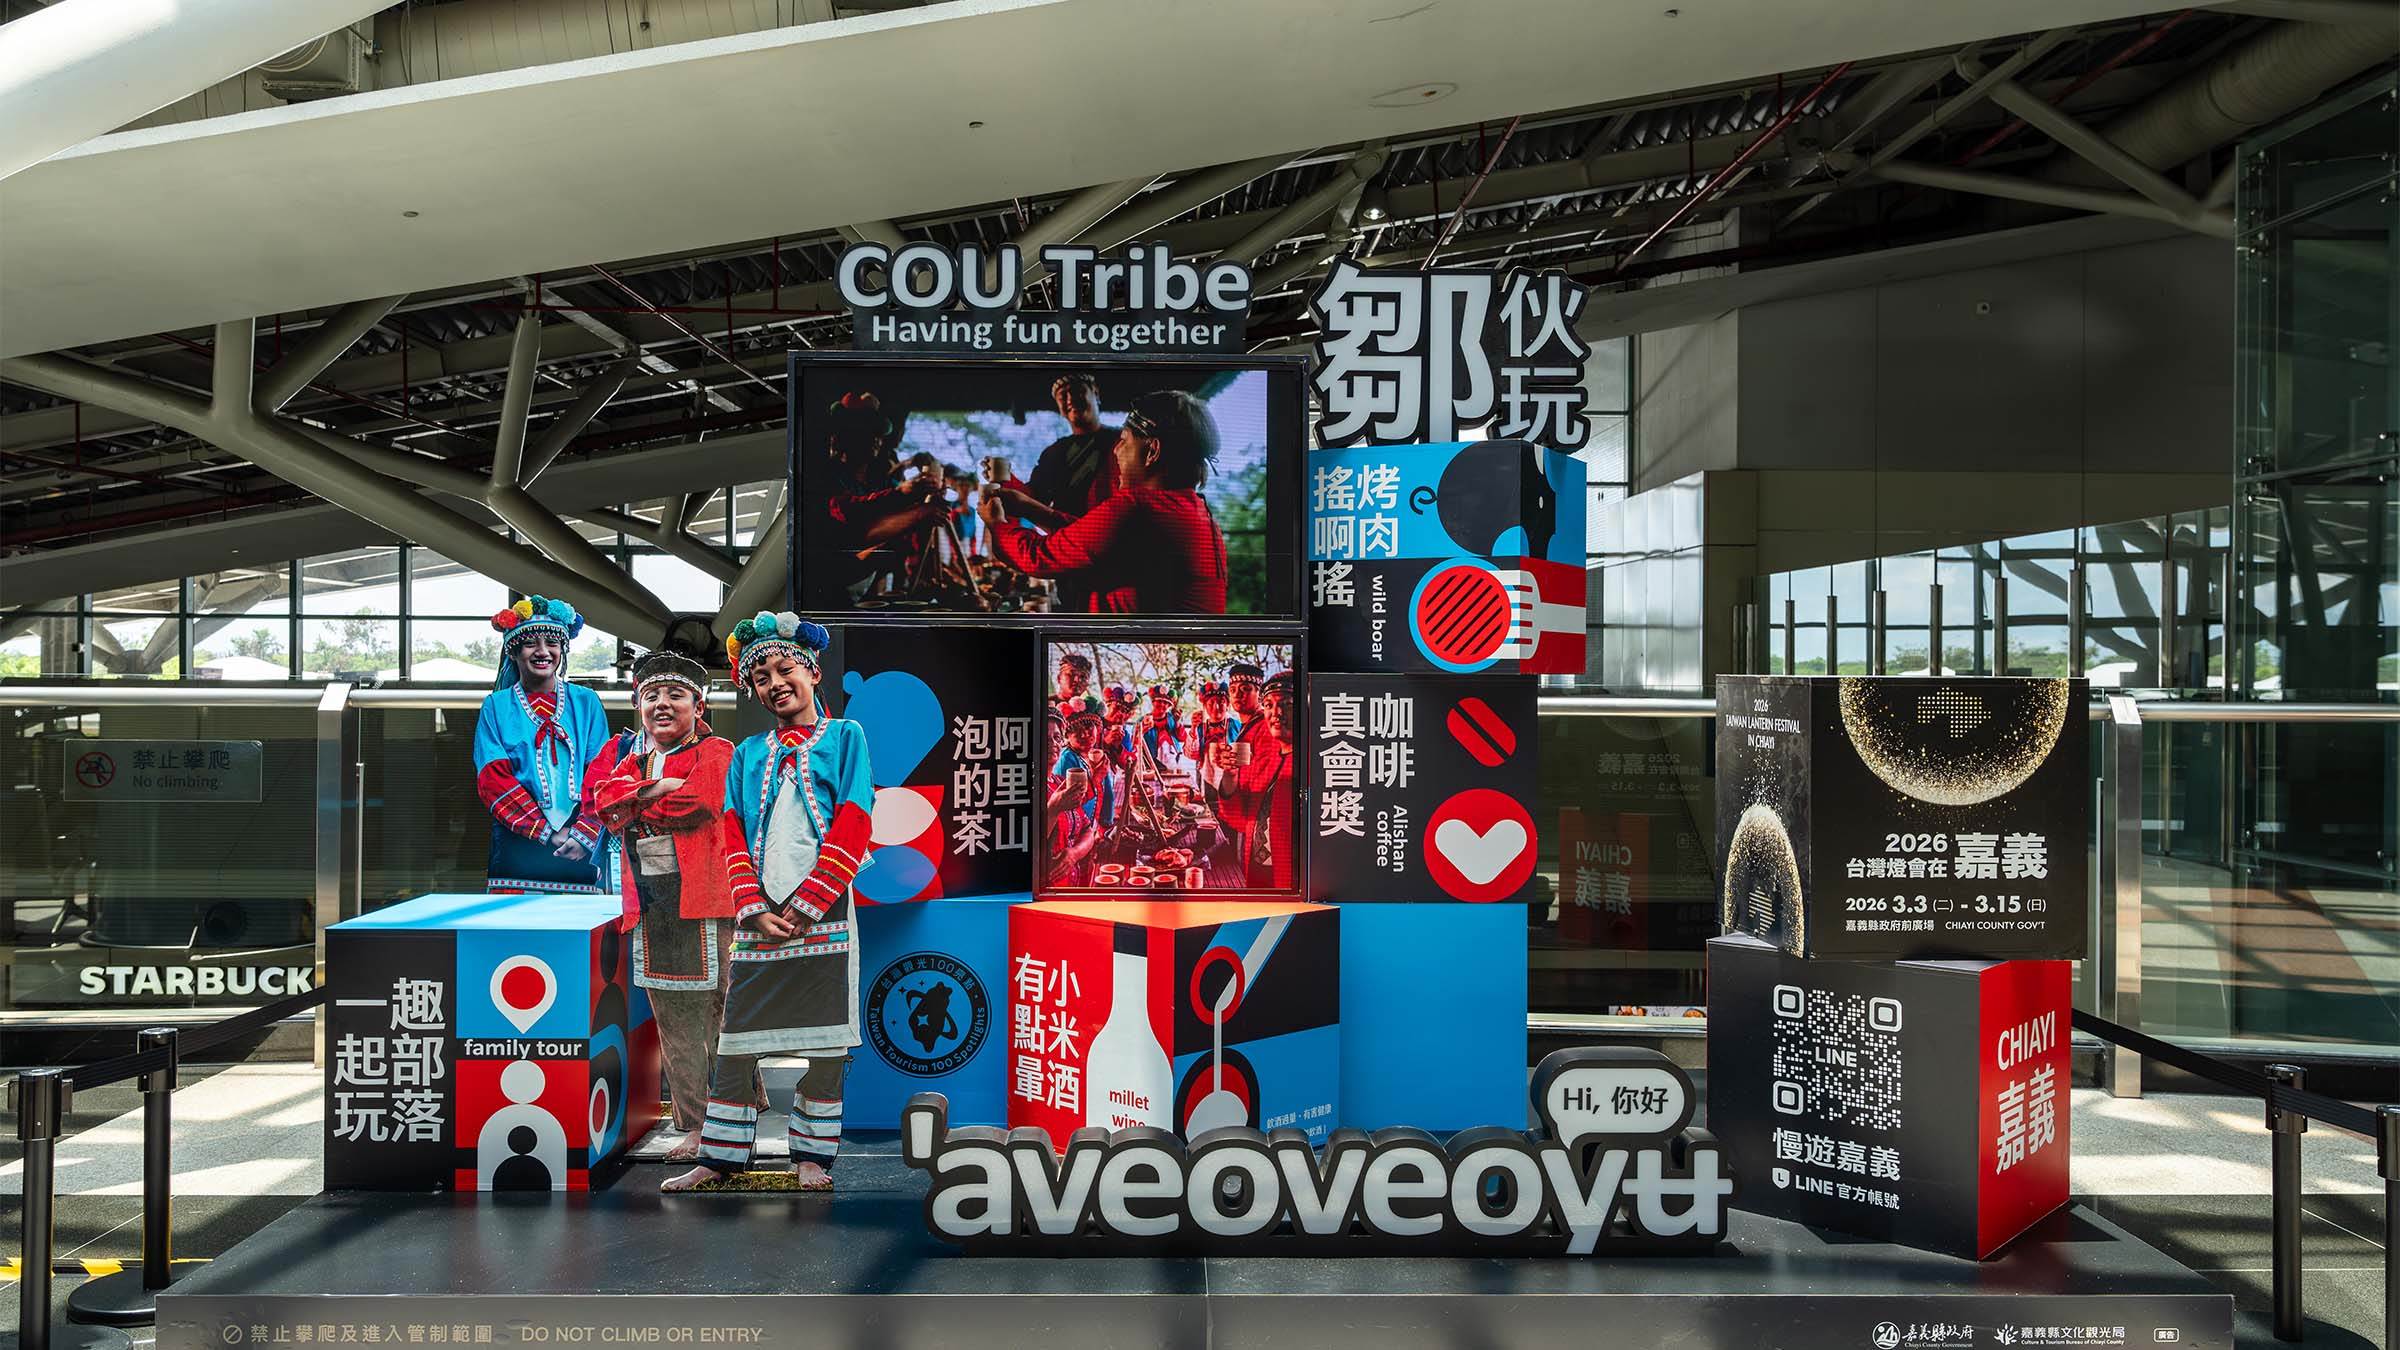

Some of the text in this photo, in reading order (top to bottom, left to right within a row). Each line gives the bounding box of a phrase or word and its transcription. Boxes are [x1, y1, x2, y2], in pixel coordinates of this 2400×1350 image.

[838, 246, 1250, 311] COU Tribe
[872, 315, 1226, 351] Having fun together
[1500, 273, 1584, 445] 伙玩
[1357, 464, 1401, 559] 烤肉
[1313, 466, 1355, 608] 搖啊搖
[1372, 574, 1387, 662] wild boar
[1725, 714, 1801, 734] TAIWAN LANTERN FESTIVAL
[1754, 699, 1768, 712] 2026
[133, 750, 231, 770] 禁止攀爬
[1369, 692, 1415, 788] 咖啡
[1748, 734, 1775, 749] IN CHIAYI
[132, 775, 219, 790] No climbing
[952, 714, 992, 857] 泡的茶
[993, 716, 1031, 853] 阿里山
[1319, 692, 1366, 837] 真會獎
[1376, 810, 1392, 867] coffee
[1393, 805, 1408, 873] Alishan
[1885, 833, 1948, 853] 2026
[1954, 832, 2048, 880] 嘉義
[1846, 858, 1948, 880] 台灣燈會在
[1846, 898, 1888, 911] 2026
[1892, 895, 1928, 914] 3.3
[1975, 895, 2022, 914] 3.15
[1846, 919, 1935, 931] 嘉義縣政府前廣場
[1945, 921, 1975, 930] CHIAYI
[1977, 921, 2015, 930] COUNTY
[79, 966, 316, 996] STARBUCK
[870, 1007, 985, 1072] Taiwan Tourism 100 Spotlights
[1013, 952, 1047, 1102] 有點暈
[1047, 959, 1081, 1115] 小米酒
[1997, 1010, 2056, 1071] CHIAYI
[333, 998, 389, 1142] 一起玩
[391, 977, 446, 1142] 趣部落
[464, 1039, 582, 1059] family tour
[1815, 1047, 1858, 1068] LINE
[1109, 1090, 1150, 1111] millet
[1563, 1086, 1669, 1115] Hi, 你好
[1996, 1063, 2056, 1175] 嘉義
[1772, 1127, 1901, 1181] 慢遊嘉義
[1795, 1174, 1901, 1211] LINE 官方帳號
[251, 1324, 493, 1344] 禁止攀爬及進入管制範圍
[521, 1327, 763, 1342] DO NOT CLIMB OR ENTRY
[2021, 1326, 2125, 1339] 嘉義縣文化觀光局
